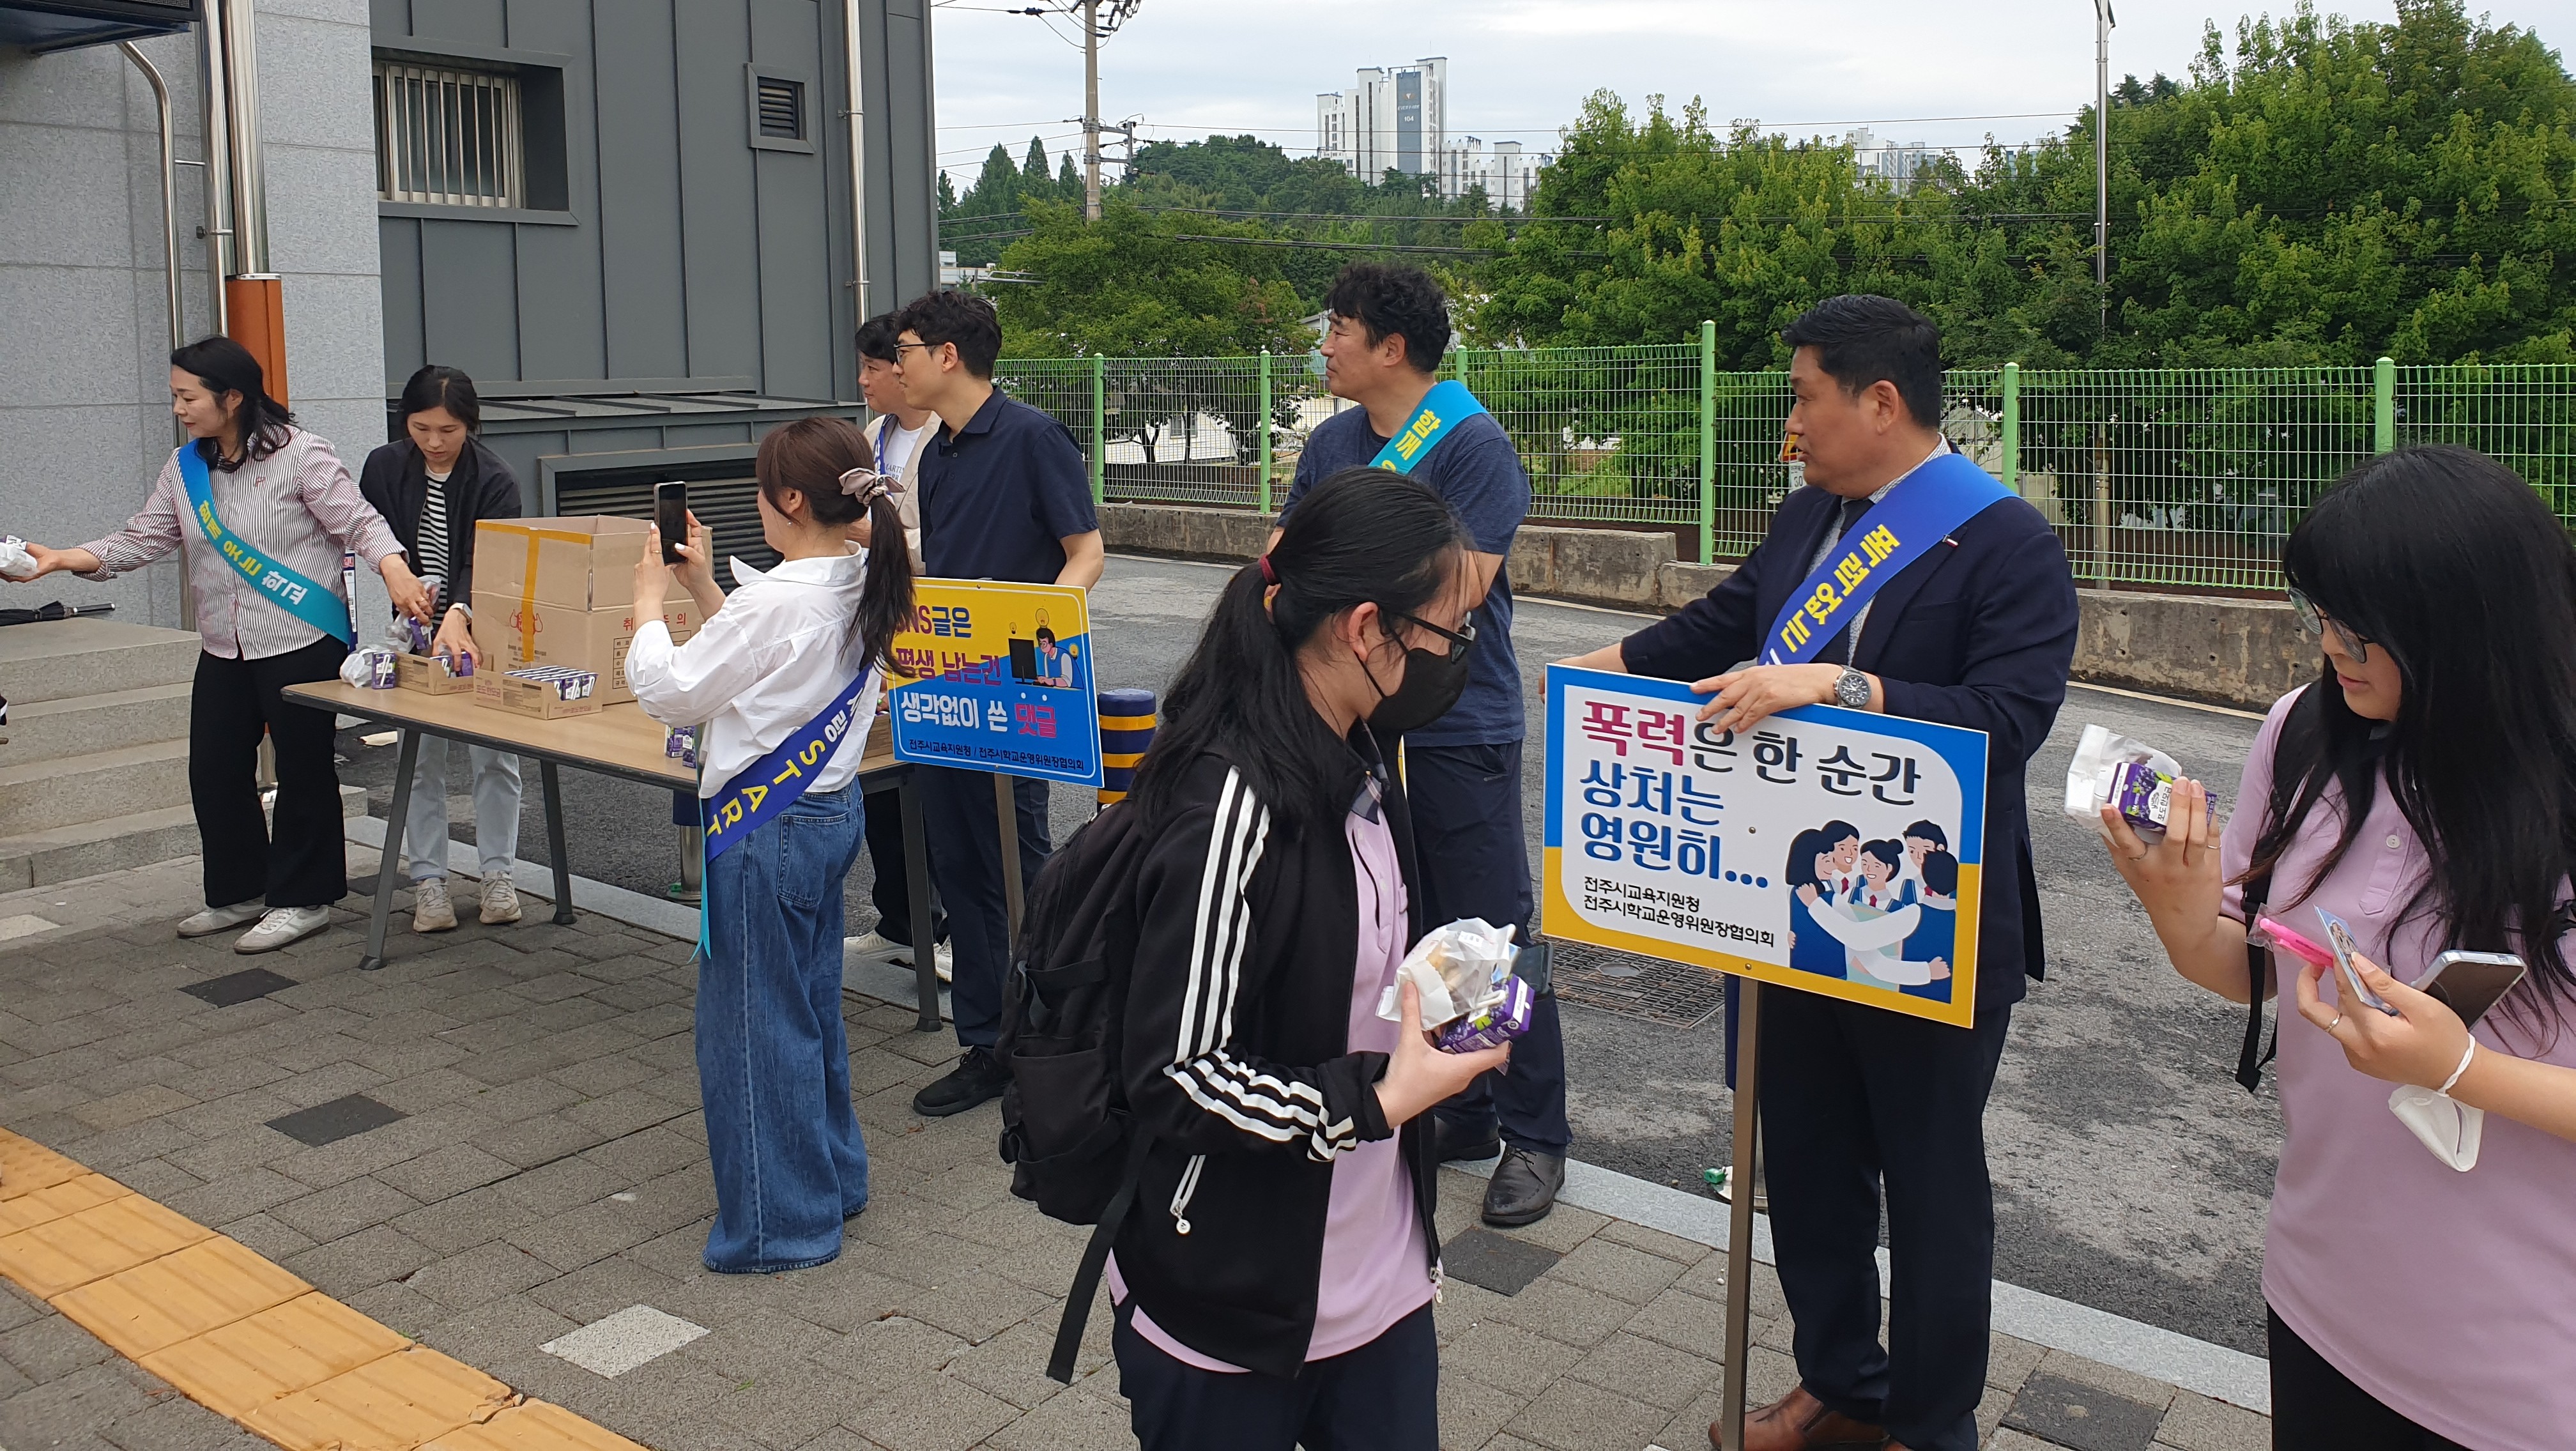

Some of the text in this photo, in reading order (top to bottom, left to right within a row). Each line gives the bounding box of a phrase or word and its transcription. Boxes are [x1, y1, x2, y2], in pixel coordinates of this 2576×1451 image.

[1395, 408, 1442, 461] 함께
[1794, 476, 1802, 488] 30
[261, 569, 309, 606] 학교
[942, 650, 1002, 686] 남는건
[901, 691, 1057, 738] 생각없이 쓴 댓글
[909, 739, 971, 756] 전주시교육지원청
[979, 746, 1084, 771] 전주시학교운영위원장협의회
[1581, 700, 1922, 806] 폭력은 한 순간
[1579, 759, 1724, 825] 상처는
[1584, 875, 1700, 913] 전주시교육지원청
[1584, 894, 1775, 948] 전주시학교운영위원장협의회
